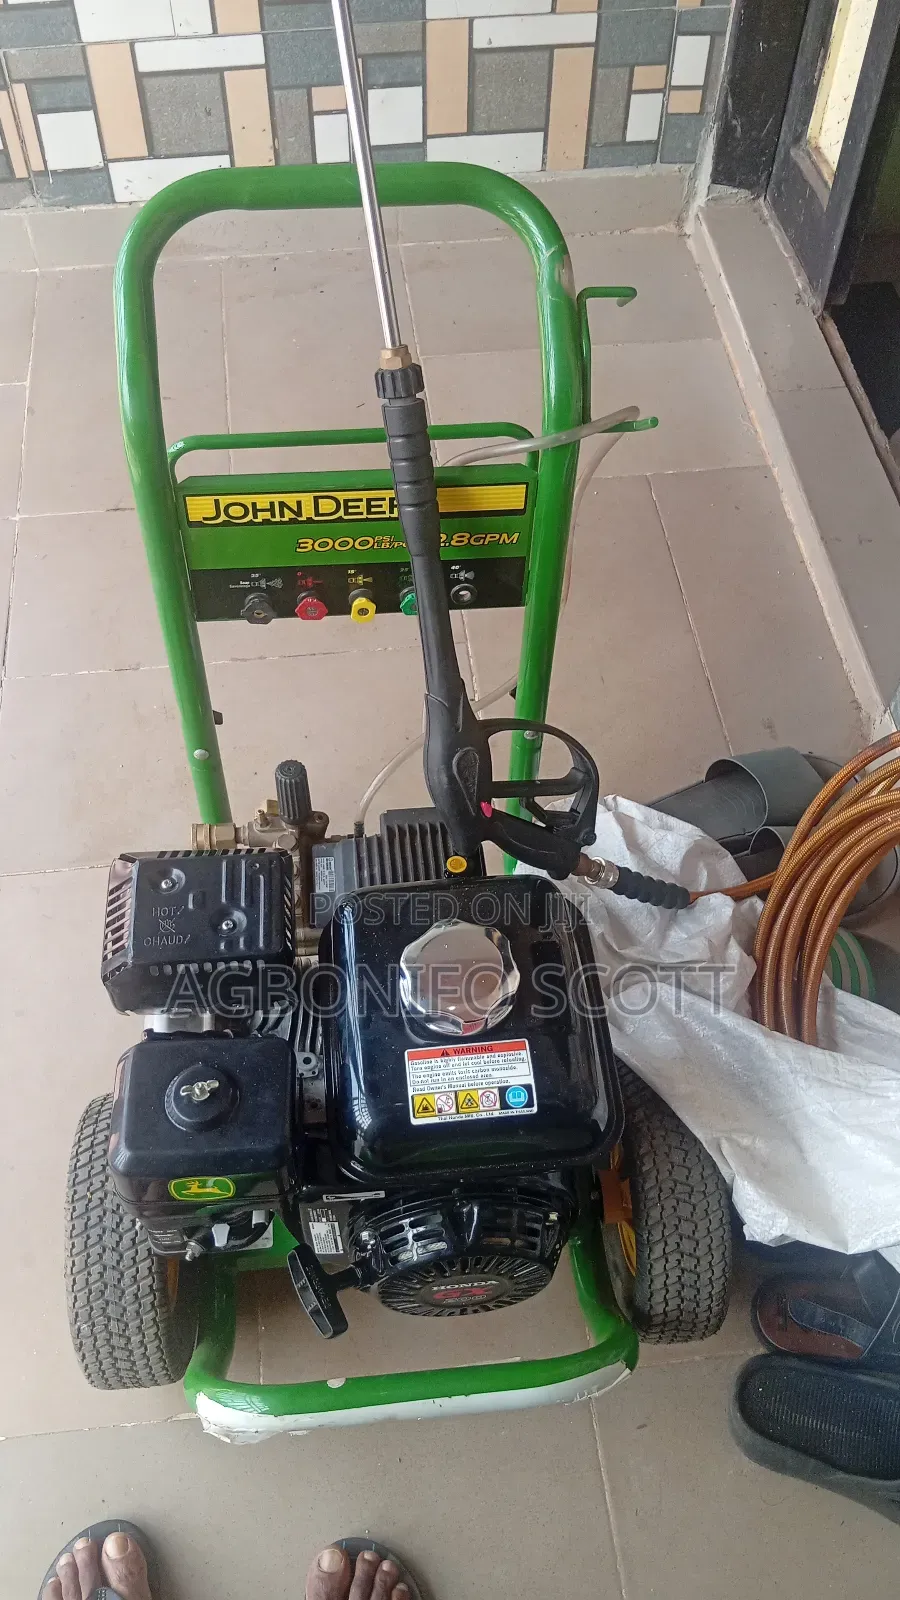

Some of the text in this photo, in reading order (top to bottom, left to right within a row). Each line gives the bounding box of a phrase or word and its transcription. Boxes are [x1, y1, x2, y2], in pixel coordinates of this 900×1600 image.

[202, 495, 398, 521] JOHN DEE
[295, 535, 374, 553] 3000
[453, 1045, 493, 1055] WARNING
[432, 1281, 499, 1290] HONDA
